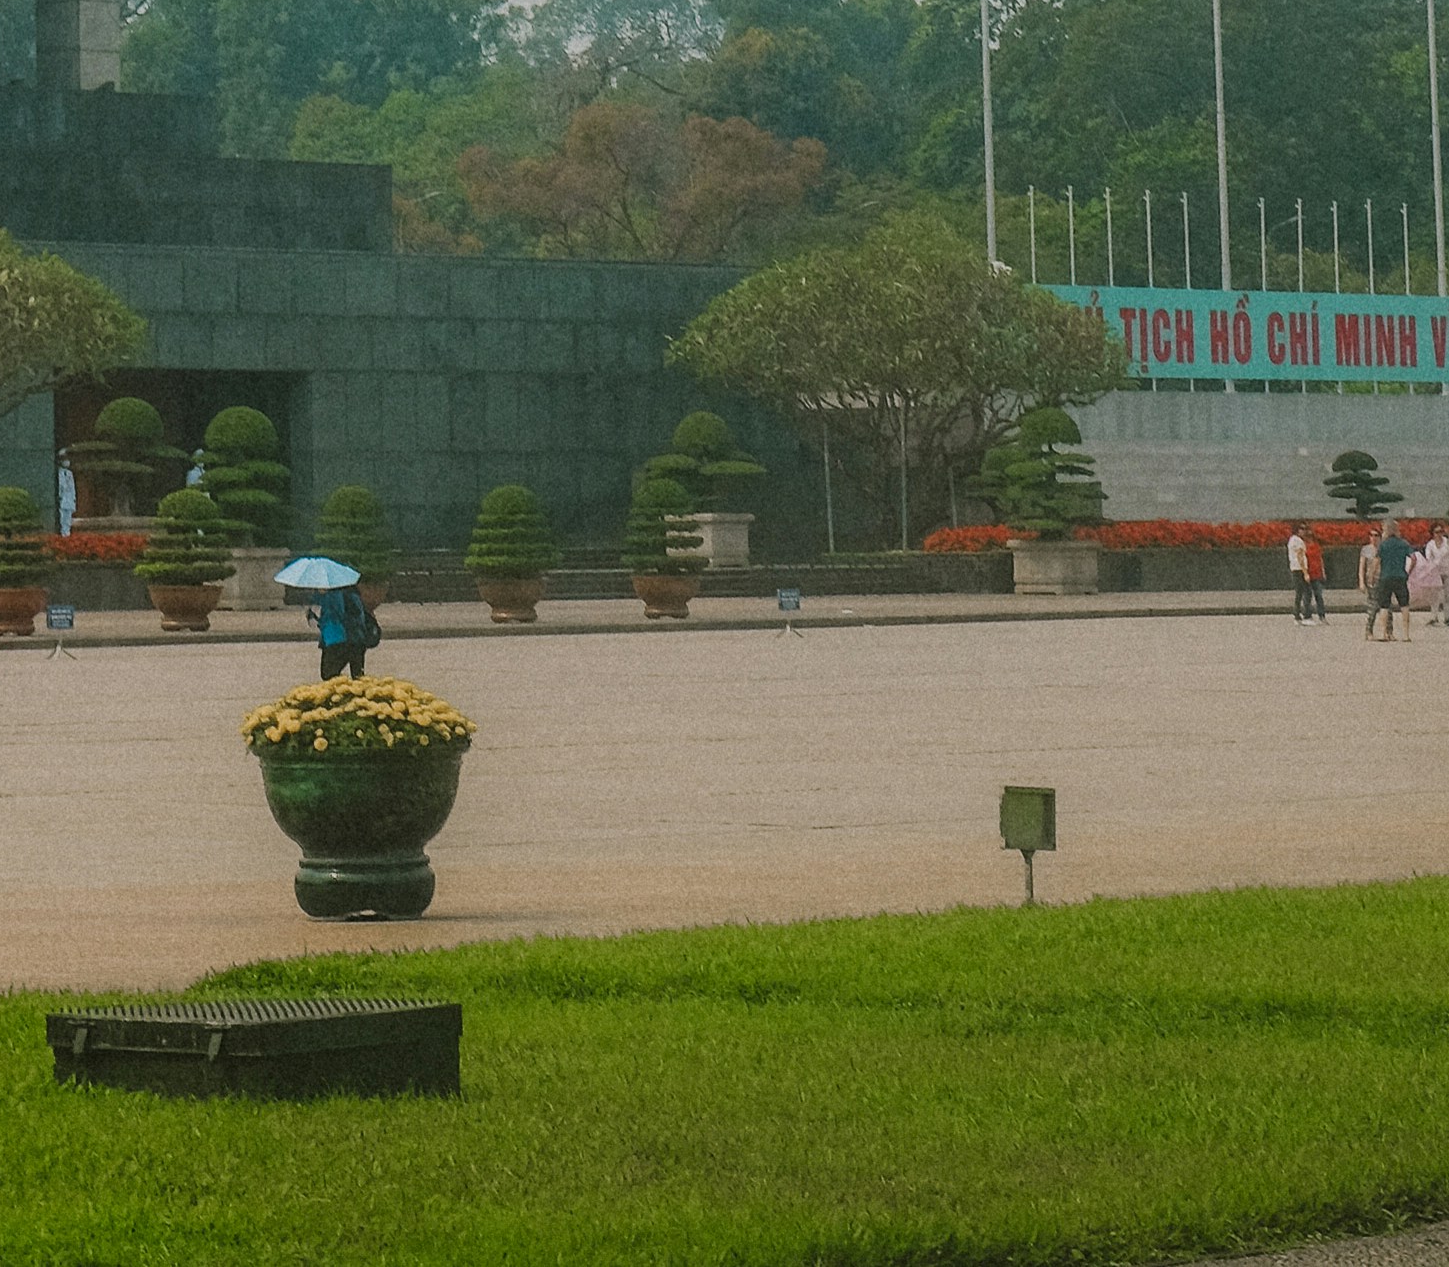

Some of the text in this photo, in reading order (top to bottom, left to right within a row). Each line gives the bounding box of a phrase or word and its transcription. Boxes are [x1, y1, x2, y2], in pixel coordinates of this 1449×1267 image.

[1119, 307, 1194, 373] TỊCH
[1209, 293, 1252, 364] HỒ
[1267, 300, 1320, 365] CHÍ
[1335, 313, 1417, 367] MINH
